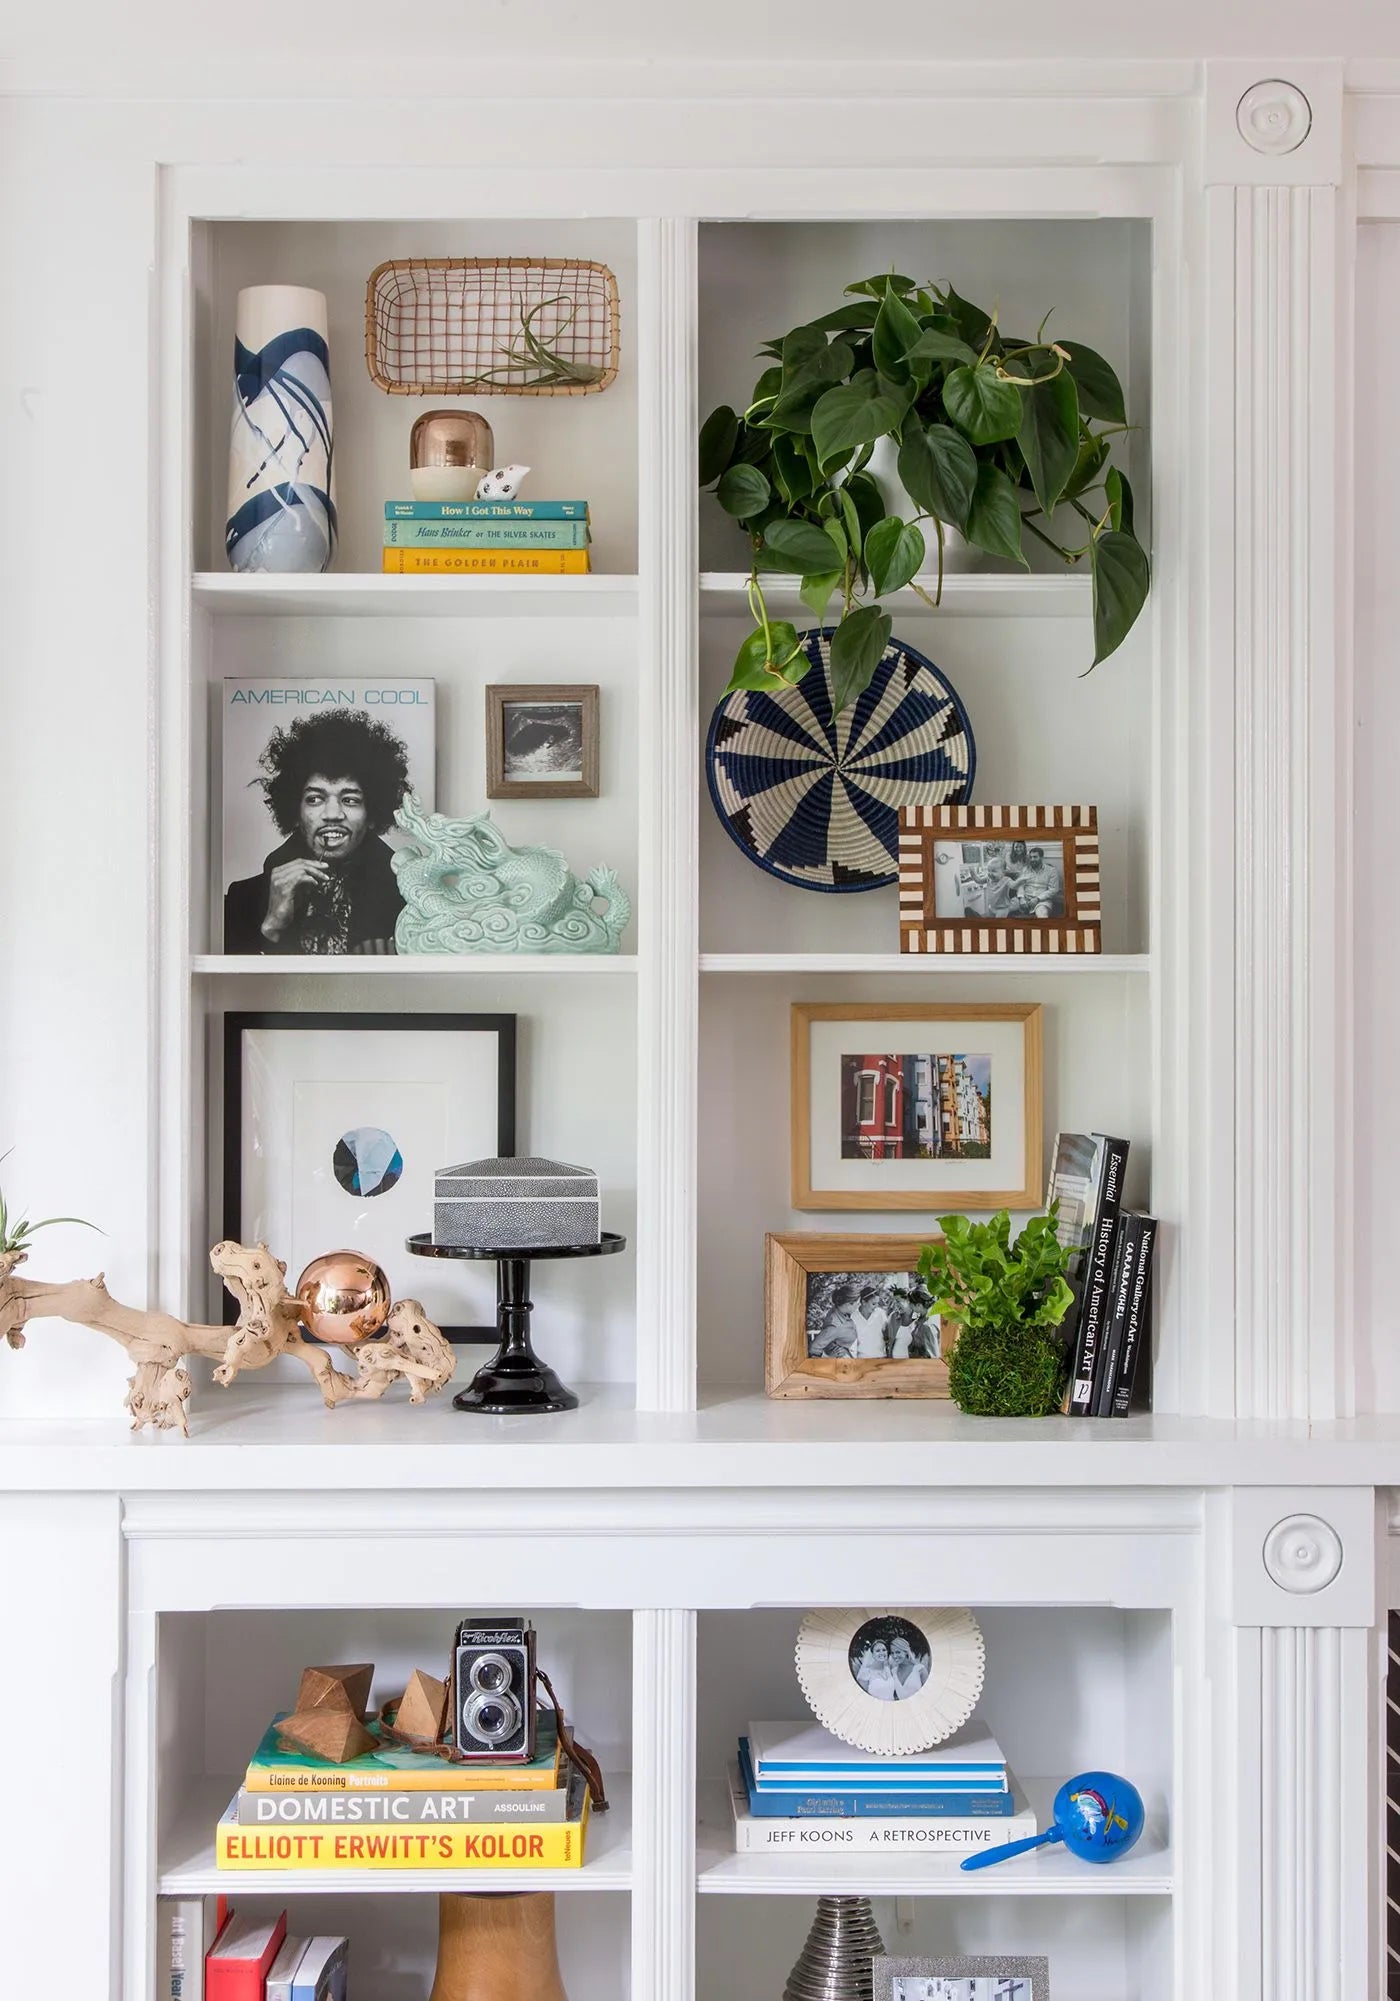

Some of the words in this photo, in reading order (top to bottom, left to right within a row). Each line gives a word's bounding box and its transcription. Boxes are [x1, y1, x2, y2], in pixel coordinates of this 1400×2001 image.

[441, 506, 463, 515] How
[465, 506, 469, 515] I
[472, 506, 488, 515] Got
[491, 506, 511, 515] This
[513, 506, 534, 517] Way
[416, 527, 440, 537] Hans
[440, 527, 472, 537] Brinker
[415, 558, 438, 566] THE
[445, 558, 496, 567] GOLDEN
[503, 559, 539, 567] PLAIN
[230, 690, 354, 704] AMERICAN
[365, 690, 428, 704] COOL
[1105, 1153, 1121, 1202] Essential
[1094, 1218, 1113, 1267] History
[1138, 1231, 1152, 1275] National
[1094, 1269, 1105, 1283] of
[1116, 1242, 1134, 1319] CARABANCHEL
[1131, 1276, 1144, 1312] Gallery
[1085, 1285, 1103, 1347] American
[1130, 1315, 1138, 1327] of
[1127, 1327, 1137, 1343] Art
[1082, 1350, 1095, 1371] Art
[269, 1774, 296, 1786] Elaine
[298, 1774, 309, 1785] de
[311, 1774, 346, 1788] Kooning
[348, 1774, 389, 1786] Portraits
[257, 1796, 410, 1821] DOMESTIC
[420, 1796, 475, 1820] ART
[494, 1803, 546, 1812] ASSOULINE
[767, 1831, 796, 1842] JEFF
[800, 1830, 853, 1842] KOONS
[869, 1831, 879, 1841] A
[883, 1830, 991, 1841] RETROSPECTIVE
[226, 1835, 323, 1859] ELLIOTT
[335, 1835, 453, 1859] ERWITT'S
[465, 1835, 544, 1858] KOLOR
